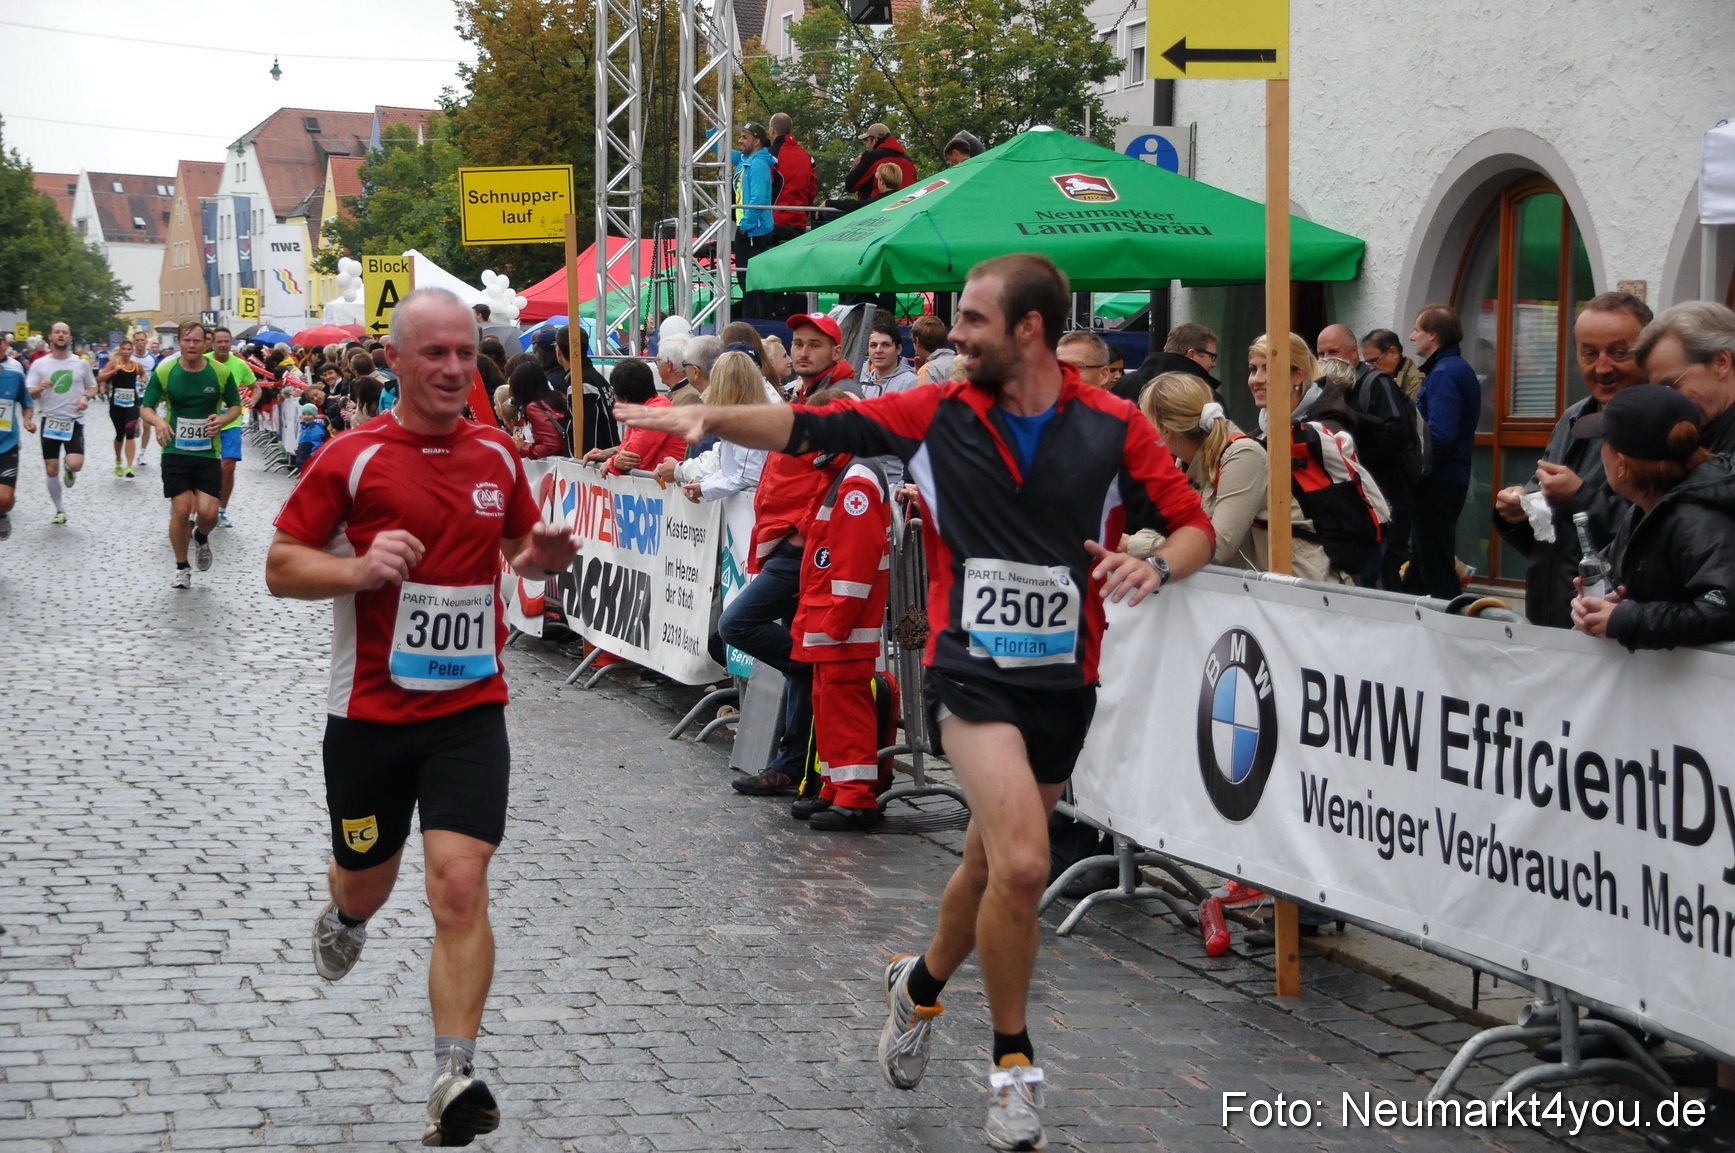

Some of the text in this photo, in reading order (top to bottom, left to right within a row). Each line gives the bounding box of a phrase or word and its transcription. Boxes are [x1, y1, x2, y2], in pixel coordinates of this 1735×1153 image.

[468, 190, 565, 207] Schnupper-
[501, 209, 533, 224] lauf
[1034, 208, 1176, 221] Neumarkter
[1014, 220, 1214, 236] Lammsbräu
[368, 259, 410, 273] Block
[244, 297, 256, 313] B
[375, 279, 400, 317] A
[48, 419, 72, 432] 2750
[664, 555, 675, 577] Im
[967, 569, 1006, 581] PARTL
[402, 592, 482, 607] PARTL Neumarkt
[665, 583, 694, 610] der Stadt
[975, 585, 1069, 629] 2502
[405, 609, 485, 651] 3001
[661, 622, 682, 648] 92318
[994, 636, 1047, 654] Florian
[428, 660, 466, 676] Peter
[1205, 632, 1272, 700] BMW
[1299, 666, 1735, 886] BMW EfficientDy
[347, 826, 375, 845] FC
[1300, 770, 1735, 959] Weniger Verbrauch. Mehr
